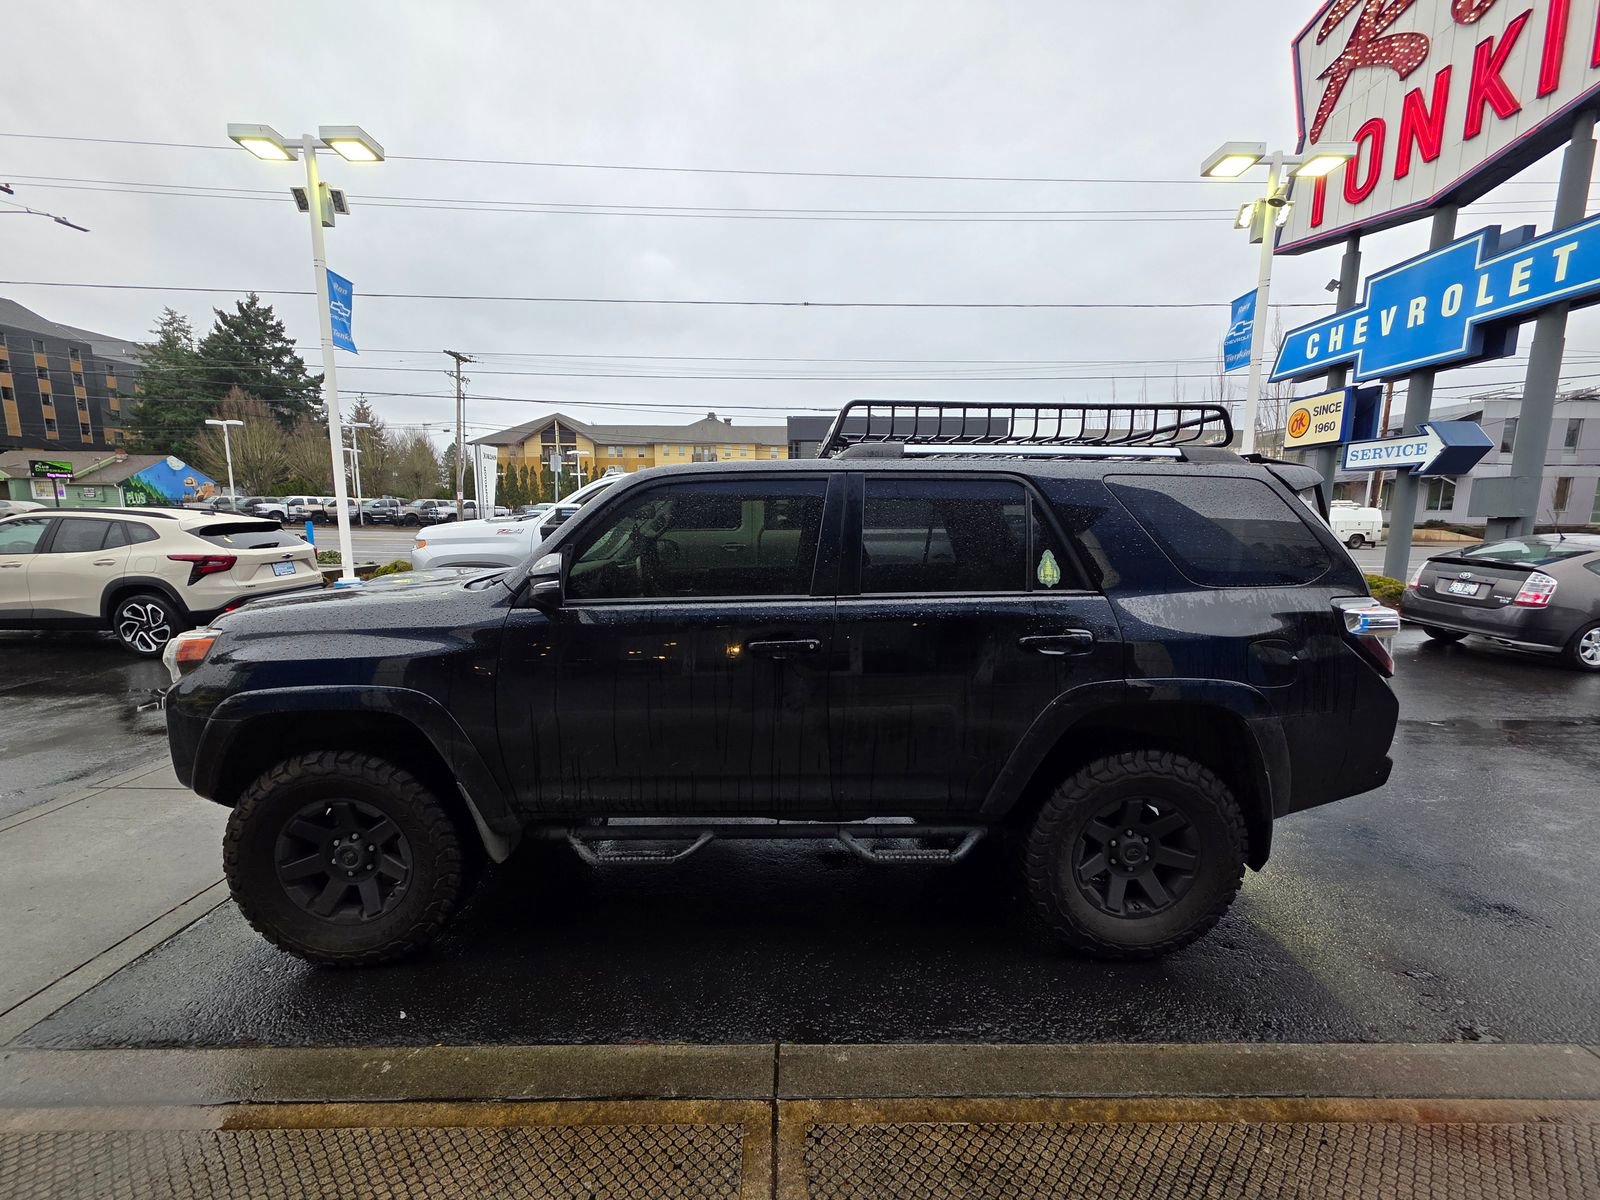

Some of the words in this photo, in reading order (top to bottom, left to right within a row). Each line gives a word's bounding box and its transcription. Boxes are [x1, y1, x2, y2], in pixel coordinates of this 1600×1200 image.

[1305, 241, 1578, 360] CHEVROLET
[1312, 401, 1342, 417] SINCE
[1314, 420, 1336, 434] 1960
[1350, 442, 1428, 462] SERVICE
[126, 491, 146, 504] PLUS
